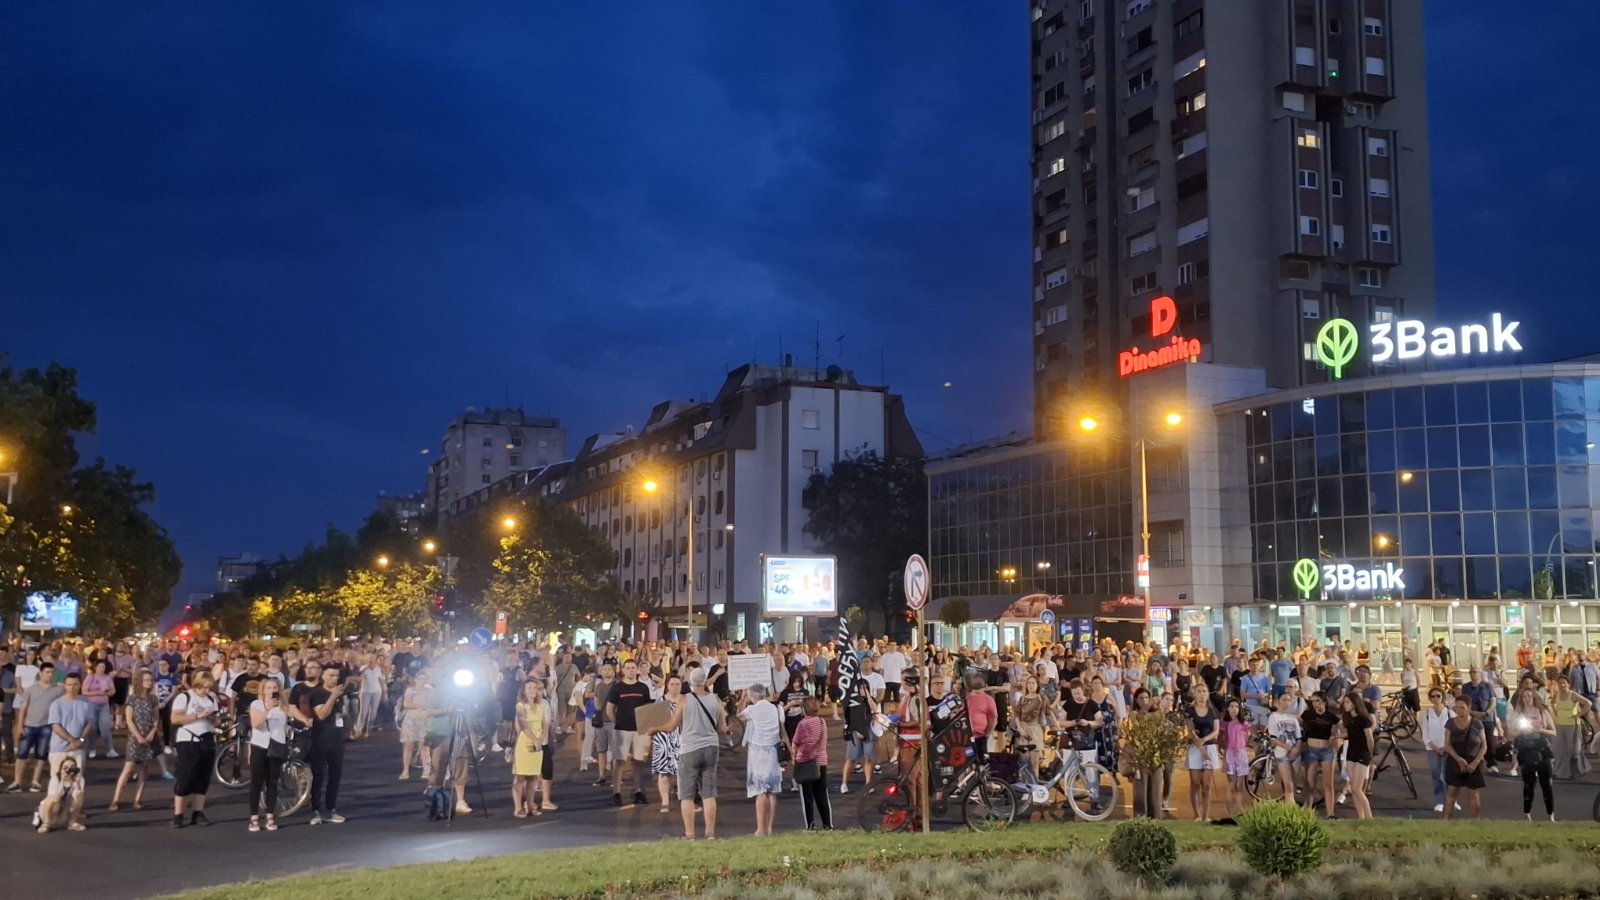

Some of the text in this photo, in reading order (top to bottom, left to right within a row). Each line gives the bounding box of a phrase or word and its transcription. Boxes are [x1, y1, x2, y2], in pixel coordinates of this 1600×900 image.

[1151, 296, 1176, 337] D
[1369, 312, 1523, 362] 3Bank
[1119, 335, 1201, 377] Dinamika
[1323, 562, 1406, 590] 3Bank
